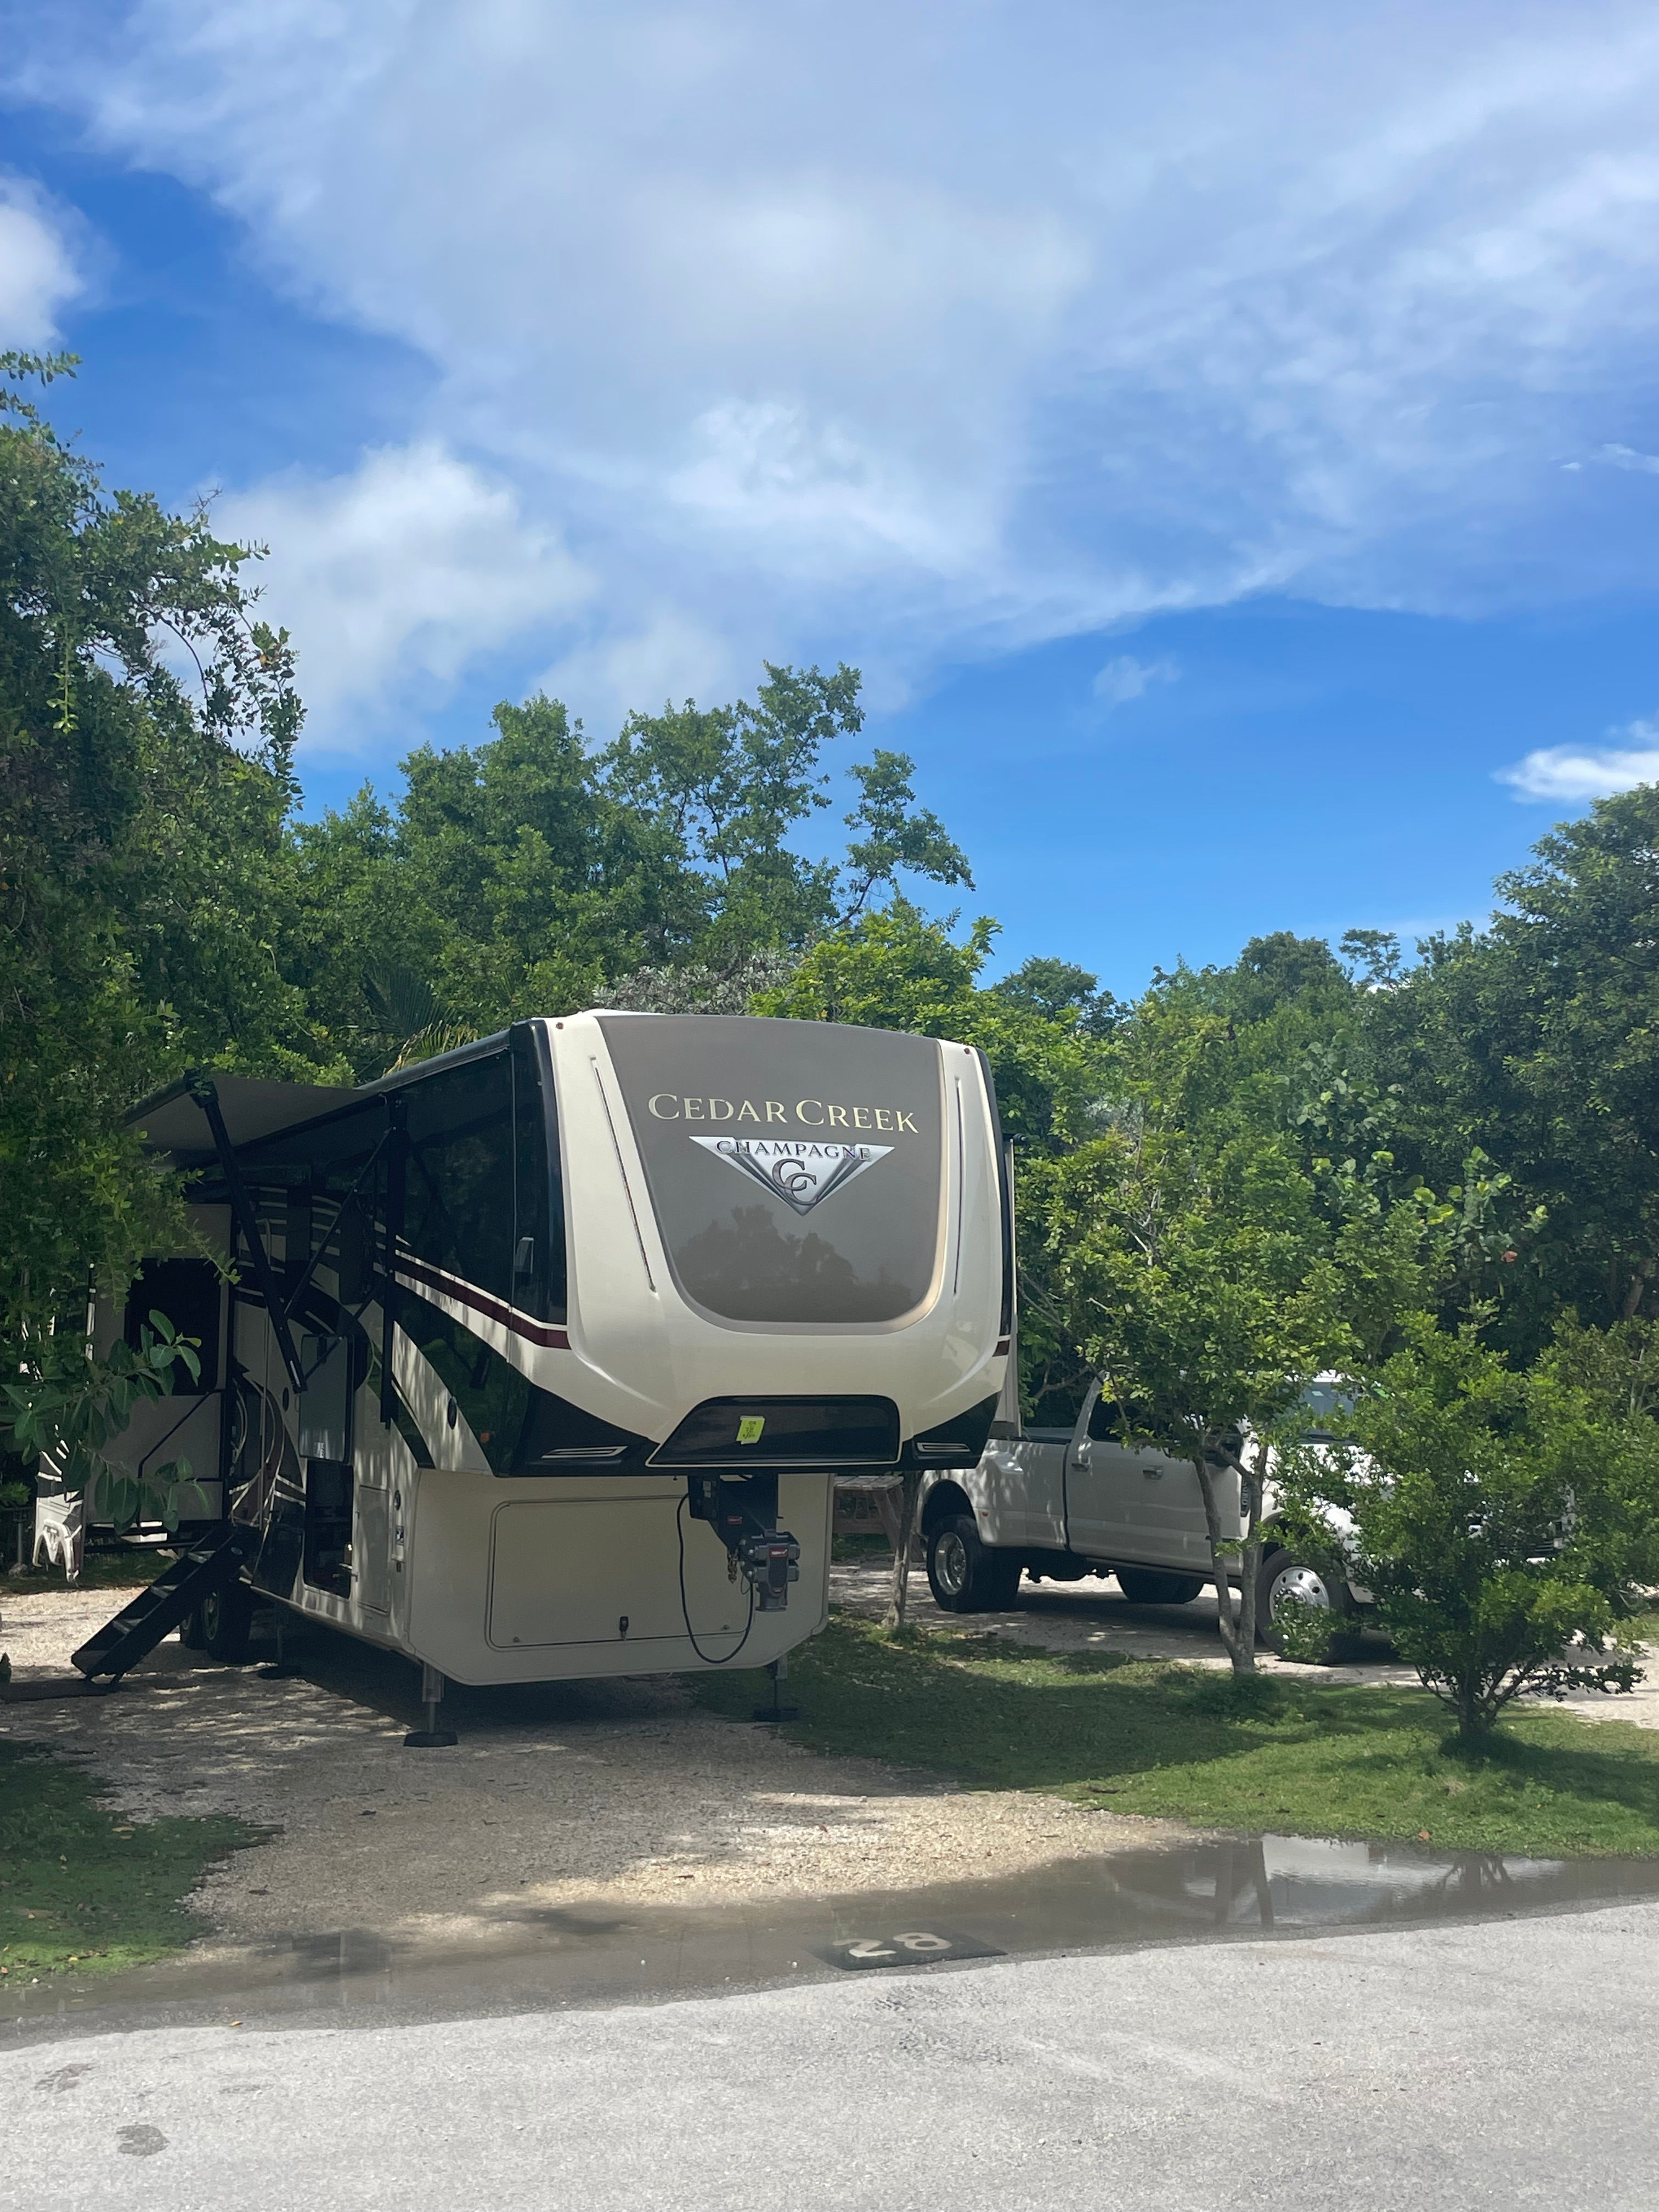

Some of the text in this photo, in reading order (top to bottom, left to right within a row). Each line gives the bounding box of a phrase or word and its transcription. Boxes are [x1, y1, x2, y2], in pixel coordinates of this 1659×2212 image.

[648, 1093, 919, 1133] CEDAR CREEK
[716, 1140, 872, 1161] CHAMPAGNE
[832, 1932, 953, 1957] 28
